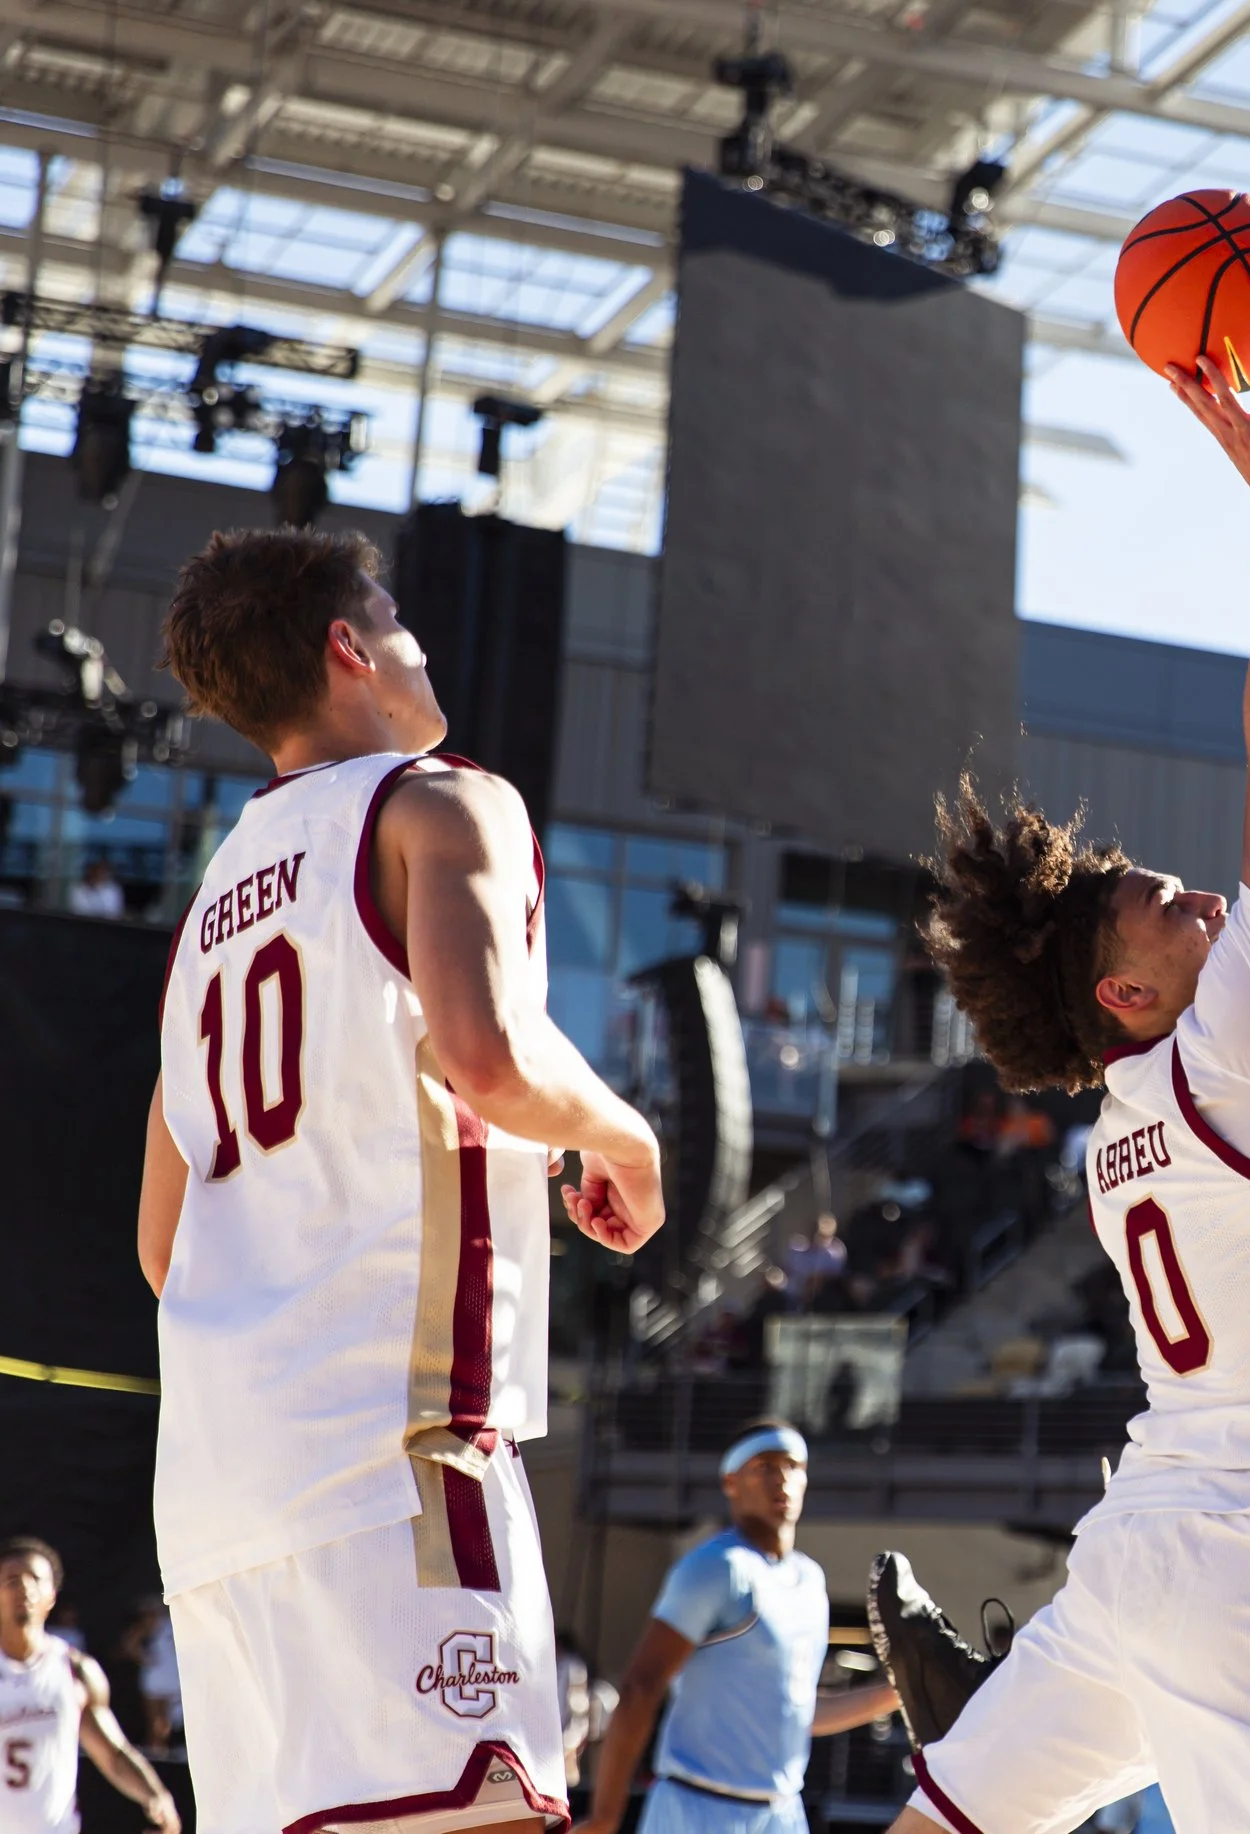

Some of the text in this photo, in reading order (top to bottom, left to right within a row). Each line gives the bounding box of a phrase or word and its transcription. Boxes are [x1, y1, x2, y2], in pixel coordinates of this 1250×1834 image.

[200, 851, 306, 954] GREEN
[197, 926, 307, 1183] 10
[1096, 1120, 1172, 1194] ABREU
[1124, 1191, 1214, 1379] 0
[416, 1664, 520, 1695] Charleston
[5, 1738, 33, 1791] 5
